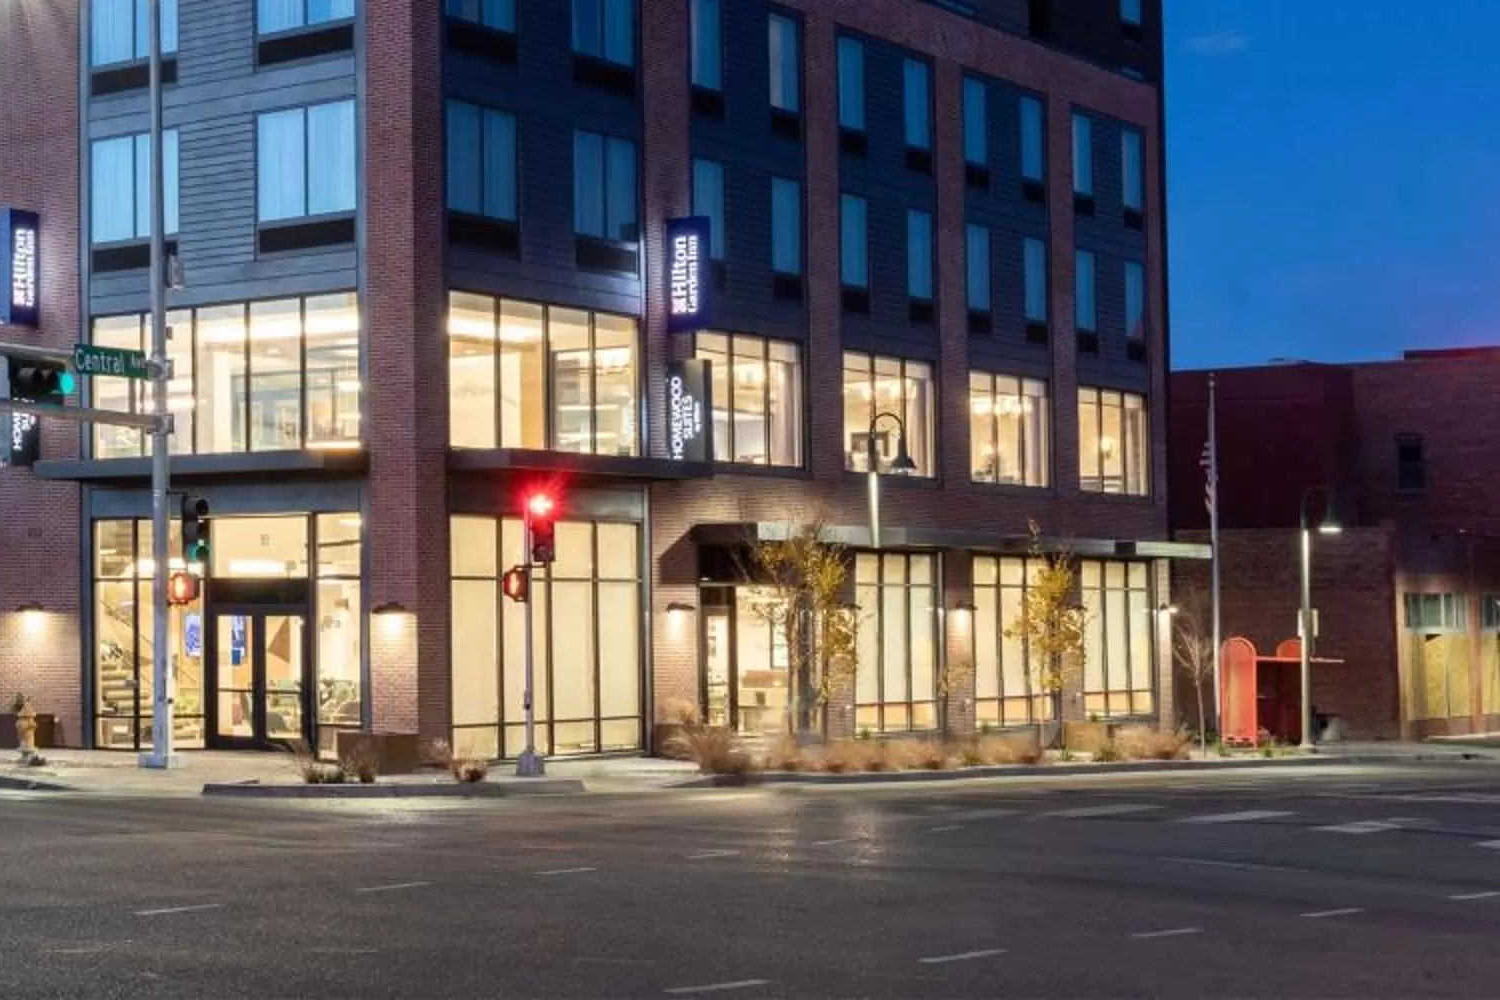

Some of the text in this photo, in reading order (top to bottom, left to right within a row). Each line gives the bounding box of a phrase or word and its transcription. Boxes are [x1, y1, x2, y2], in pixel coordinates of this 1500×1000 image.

[671, 235, 687, 297] Hilton
[75, 348, 125, 374] Central
[671, 376, 683, 460] HOMEWOOD
